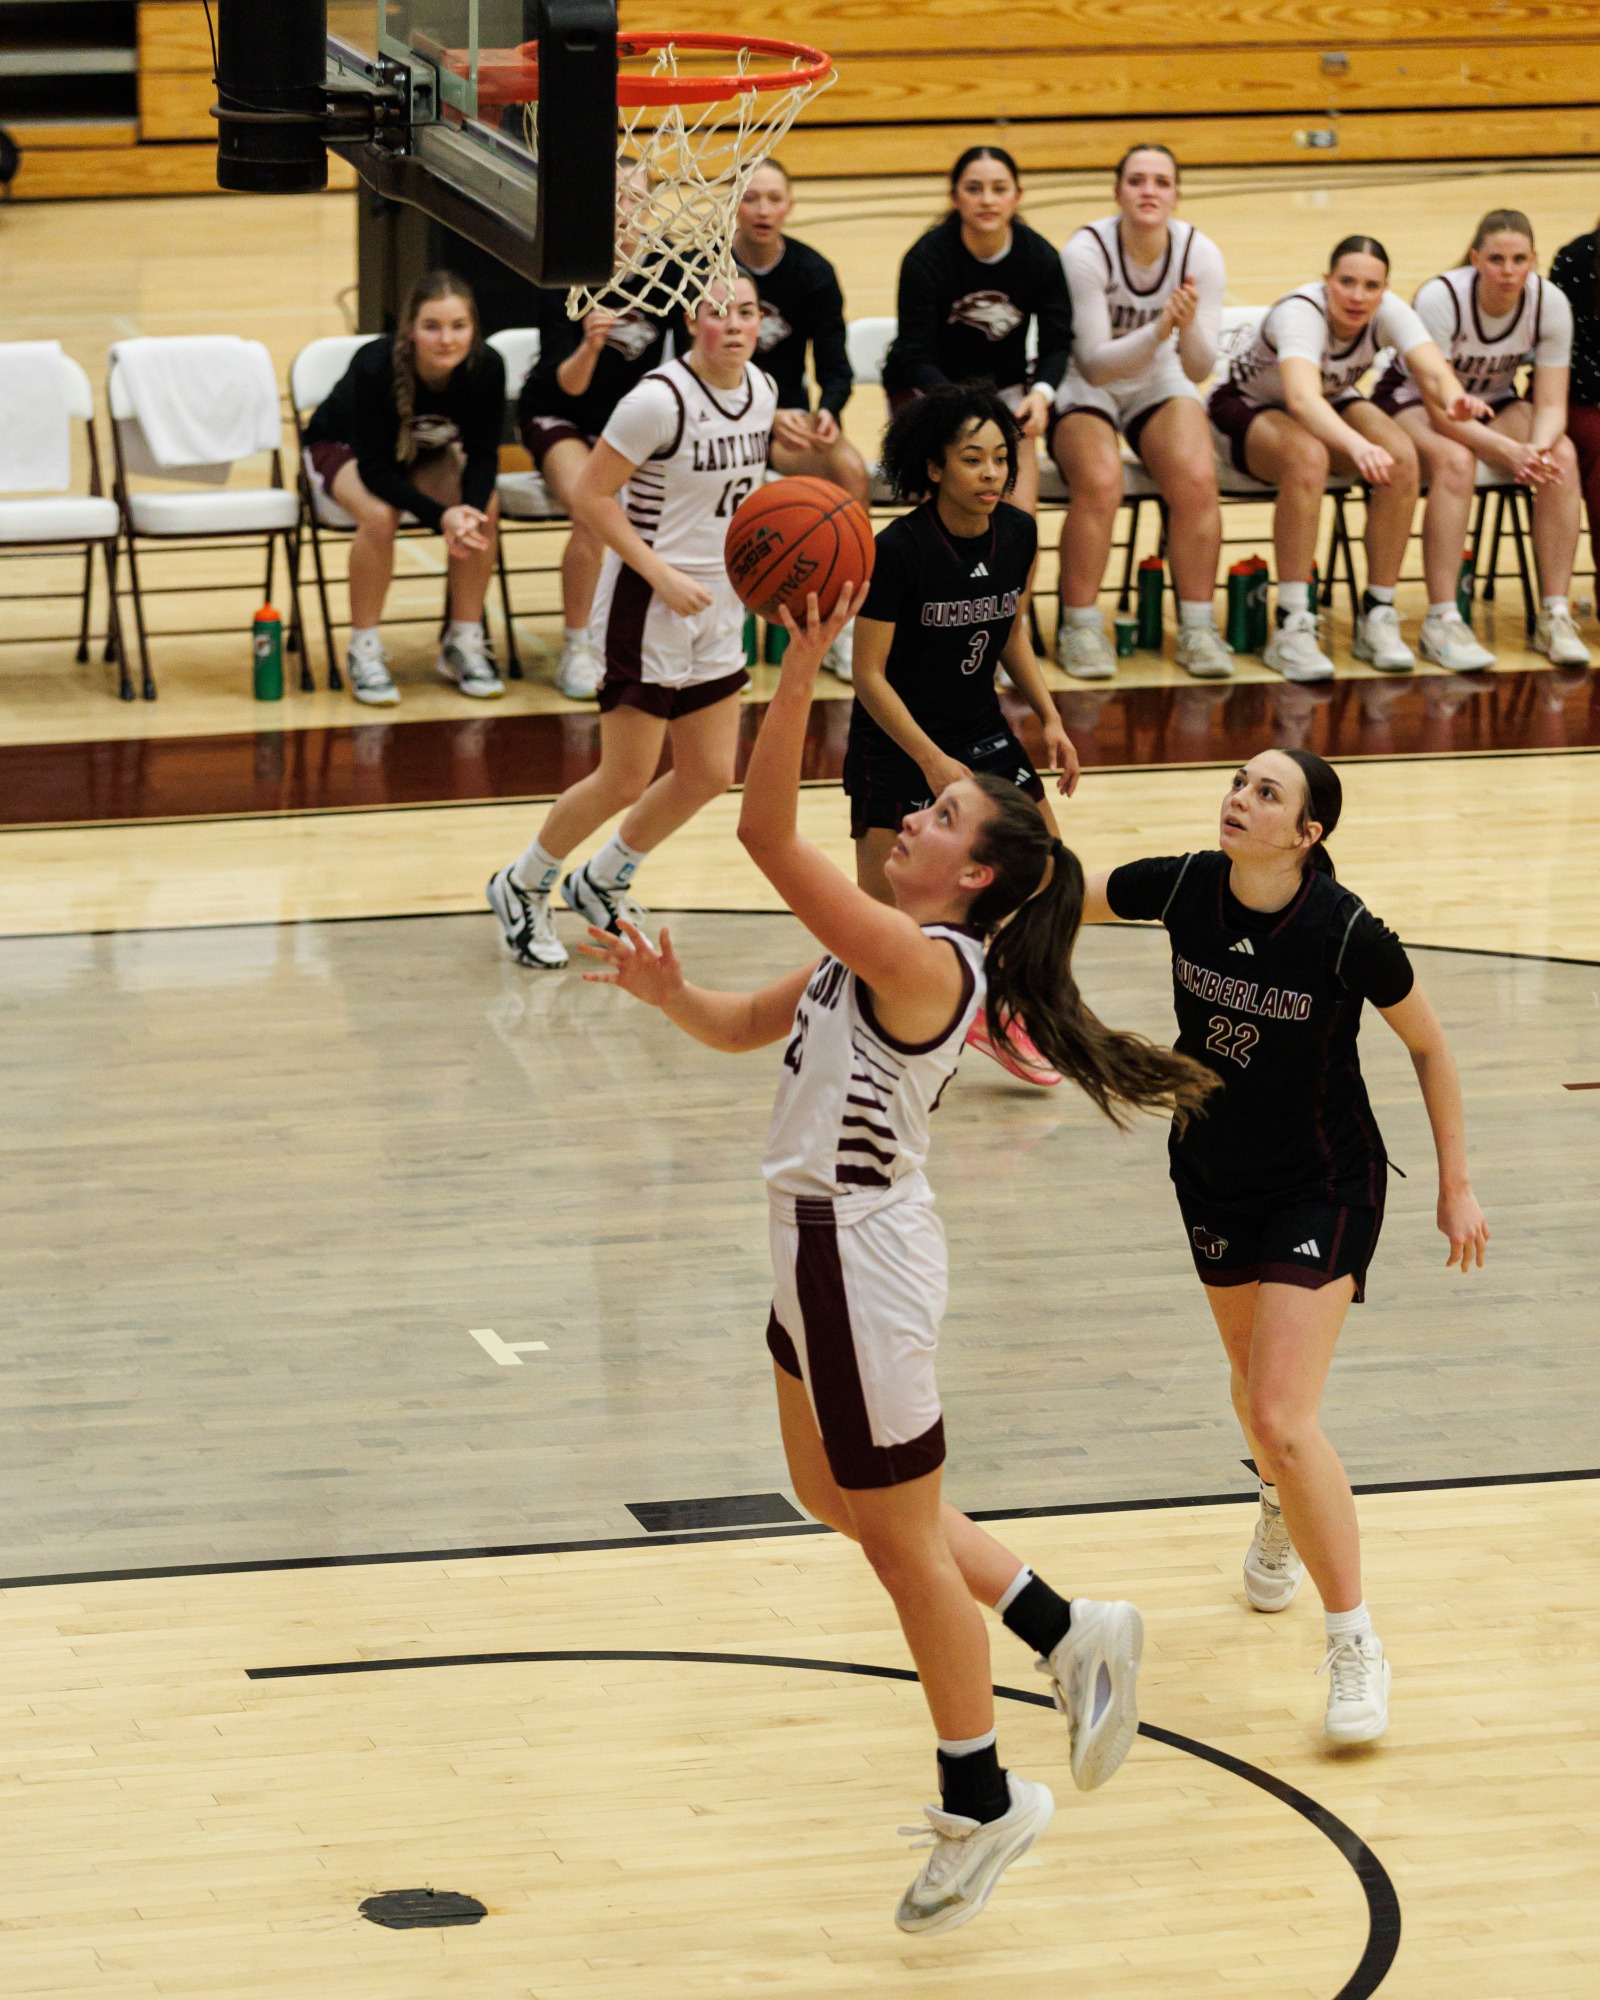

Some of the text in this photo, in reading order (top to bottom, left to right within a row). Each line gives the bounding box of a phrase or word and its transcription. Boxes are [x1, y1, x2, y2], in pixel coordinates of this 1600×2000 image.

[692, 436, 737, 472] LADY
[921, 587, 1021, 627] CUMBERLAN
[961, 630, 990, 675] 3
[1175, 954, 1313, 1021] CUMBERLAND
[1206, 1015, 1260, 1069] 22
